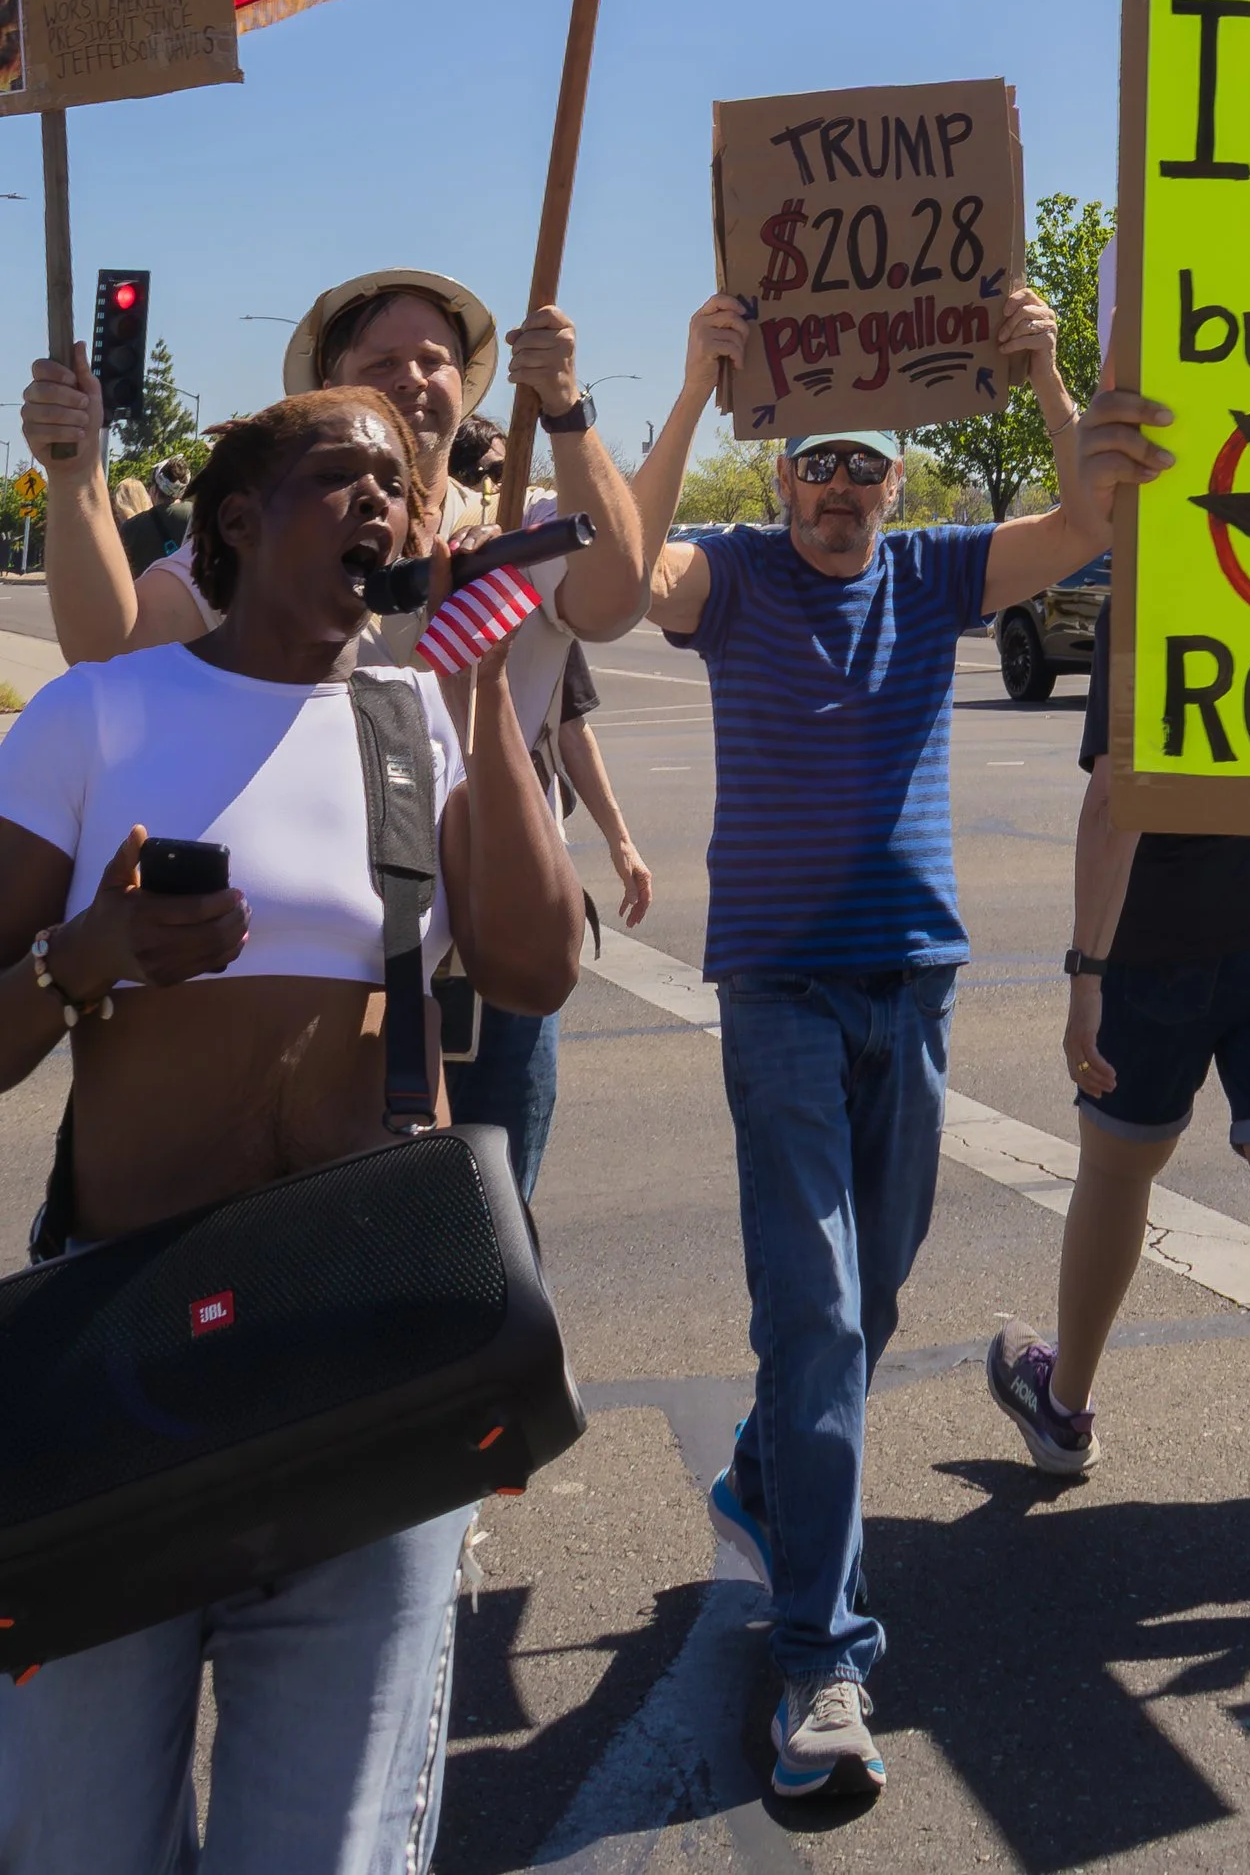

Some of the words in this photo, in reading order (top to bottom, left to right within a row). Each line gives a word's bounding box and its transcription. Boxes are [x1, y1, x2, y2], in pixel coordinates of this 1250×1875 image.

[48, 15, 138, 54] PRESIDENT
[144, 1, 193, 34] SINCE
[55, 35, 158, 79] JEFFERSON
[165, 26, 216, 62] DAVIS
[770, 112, 974, 186] TRUMP
[759, 197, 985, 302] $20.28
[759, 309, 856, 401] per
[852, 295, 990, 392] gallon
[199, 1301, 227, 1323] JBL
[1010, 1375, 1038, 1413] HOKA
